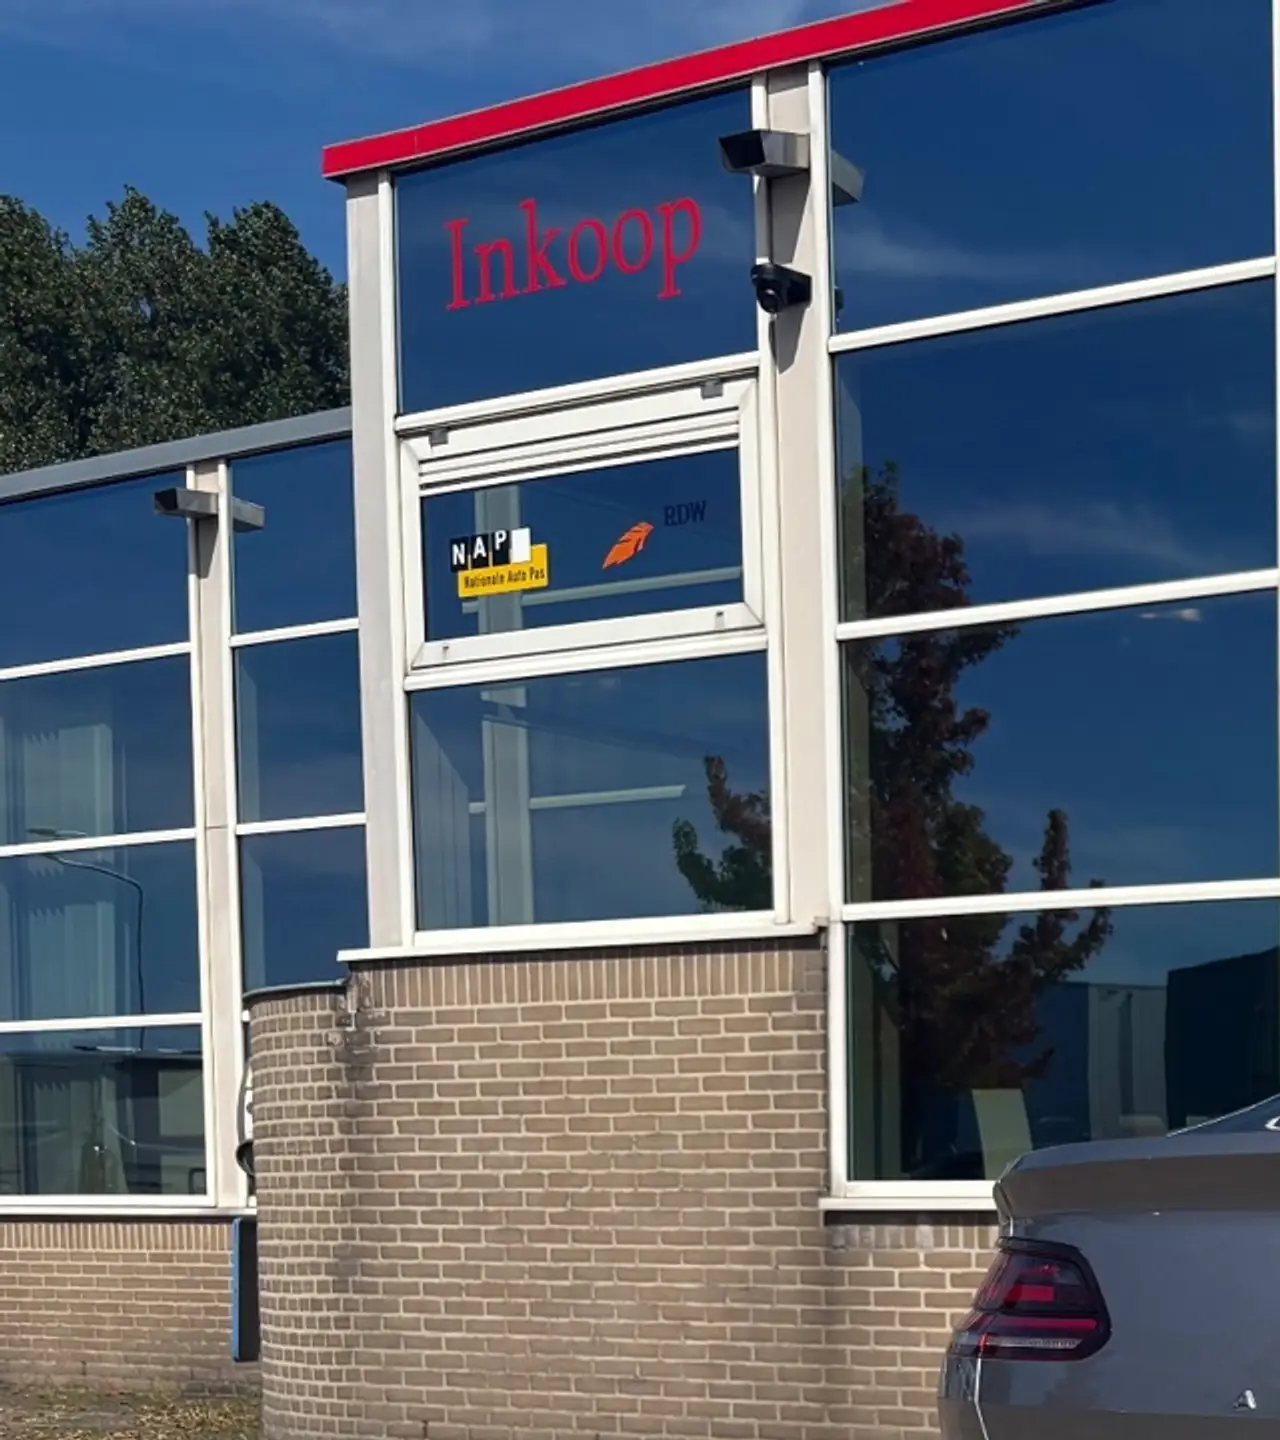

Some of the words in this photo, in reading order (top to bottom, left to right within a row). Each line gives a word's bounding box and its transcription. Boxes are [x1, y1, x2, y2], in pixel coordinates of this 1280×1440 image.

[444, 196, 702, 310] Inkoop
[664, 500, 706, 527] RDW
[451, 529, 507, 566] NAP
[464, 571, 505, 588] Nationale
[507, 570, 527, 584] Auto
[530, 566, 545, 581] Pas
